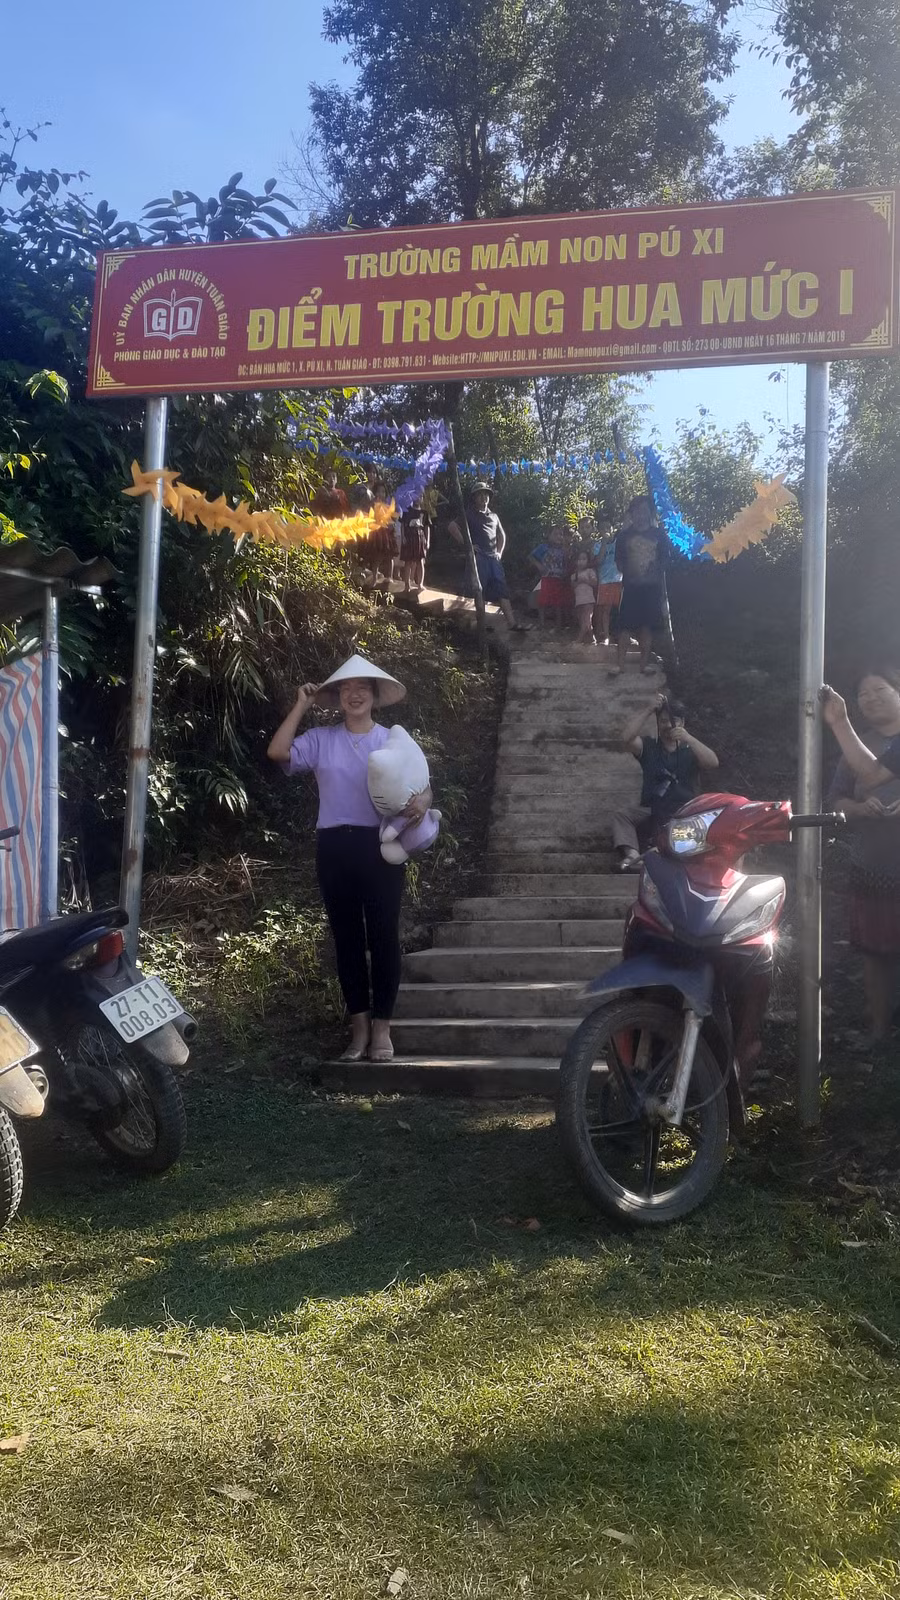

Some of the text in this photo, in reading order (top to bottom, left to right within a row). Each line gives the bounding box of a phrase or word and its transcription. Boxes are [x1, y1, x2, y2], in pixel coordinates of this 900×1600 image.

[343, 225, 724, 280] TRƯỜNG MẦM NON PÚ XI
[118, 303, 134, 328] BAN
[130, 277, 156, 304] NHÂN
[156, 268, 176, 285] DÂN
[178, 268, 209, 289] HUYỆN
[218, 312, 230, 340] GIÁO
[246, 287, 362, 352] ĐIỂM
[377, 282, 565, 344] TRƯỜNG
[582, 282, 683, 332] HUA
[701, 261, 819, 325] MỨC
[114, 345, 226, 362] PHÒNG GIÁO DỤC & ĐÀO TẠO
[263, 362, 276, 374] HUA
[277, 359, 291, 374] MỨC
[307, 358, 316, 372] PÚ
[352, 356, 368, 370] GIÁO
[542, 347, 567, 360] EMAIL:
[695, 338, 709, 351] 273
[744, 333, 764, 348] NGÀY
[765, 334, 775, 347] 16
[776, 332, 801, 346] THÁNG
[802, 332, 807, 344] 7
[808, 331, 826, 344] NĂM
[110, 983, 159, 1018] 27-T1
[120, 997, 177, 1037] 008.03
